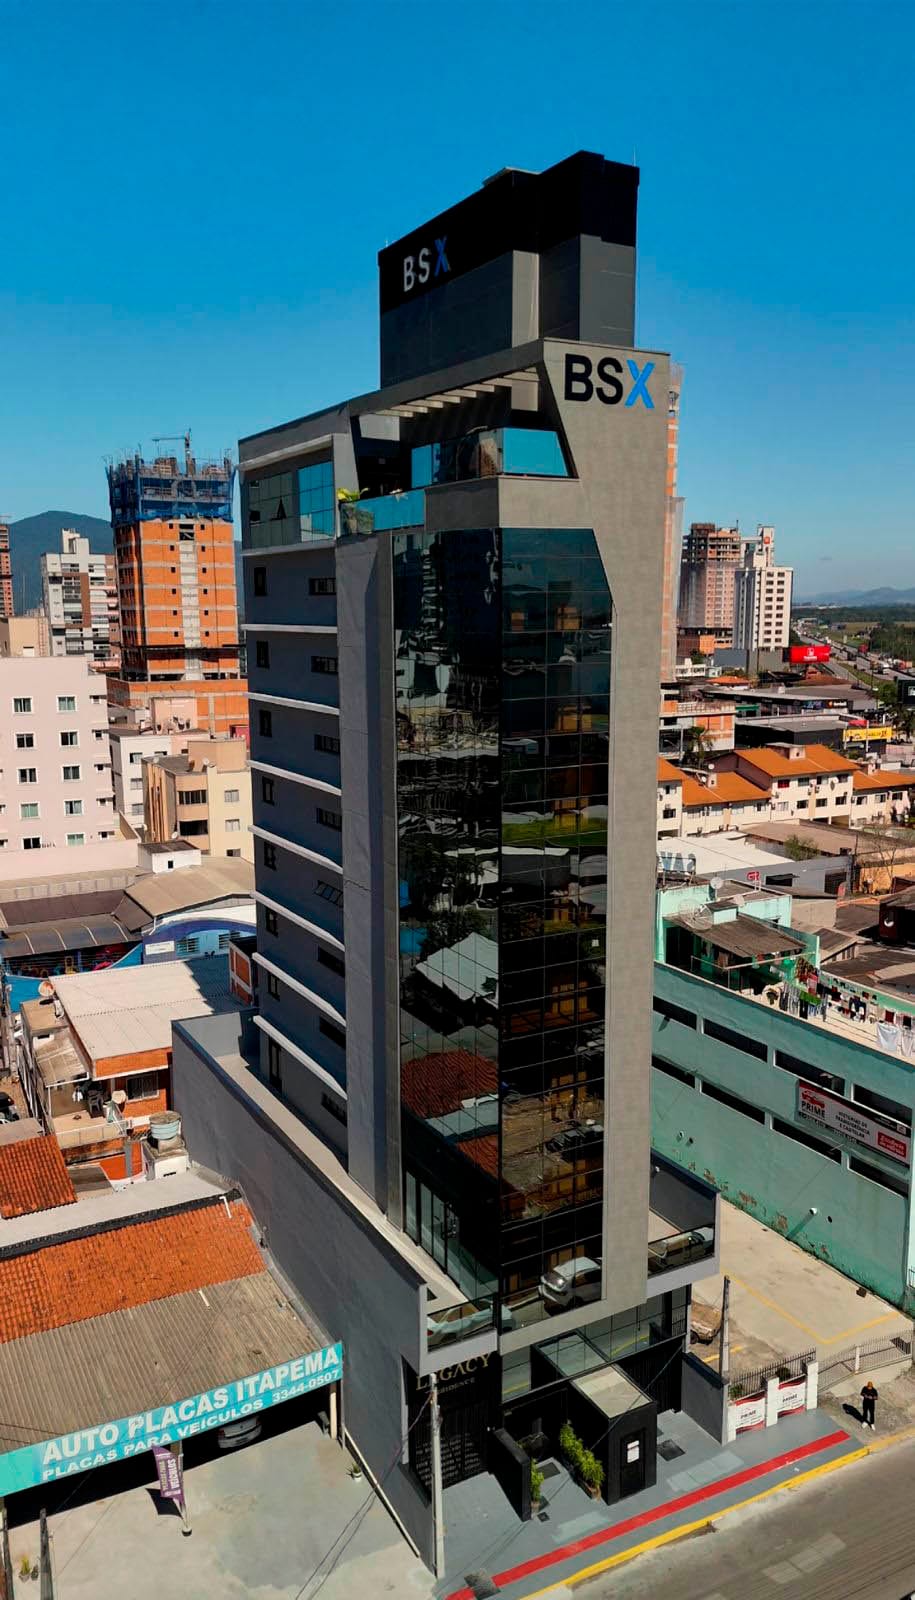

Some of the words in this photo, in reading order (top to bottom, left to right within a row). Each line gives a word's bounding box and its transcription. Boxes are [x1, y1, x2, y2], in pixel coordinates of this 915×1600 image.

[403, 236, 450, 292] BSX
[564, 353, 655, 408] BSX
[801, 1101, 825, 1119] PRIME
[416, 1354, 490, 1390] LGACY
[42, 1450, 118, 1481] PLACAS
[124, 1433, 172, 1456] PARA
[272, 1370, 339, 1402] 3344-0507
[43, 1424, 119, 1464] AUTO
[128, 1388, 228, 1438] PLACAS
[236, 1347, 339, 1401] ITAPEMA
